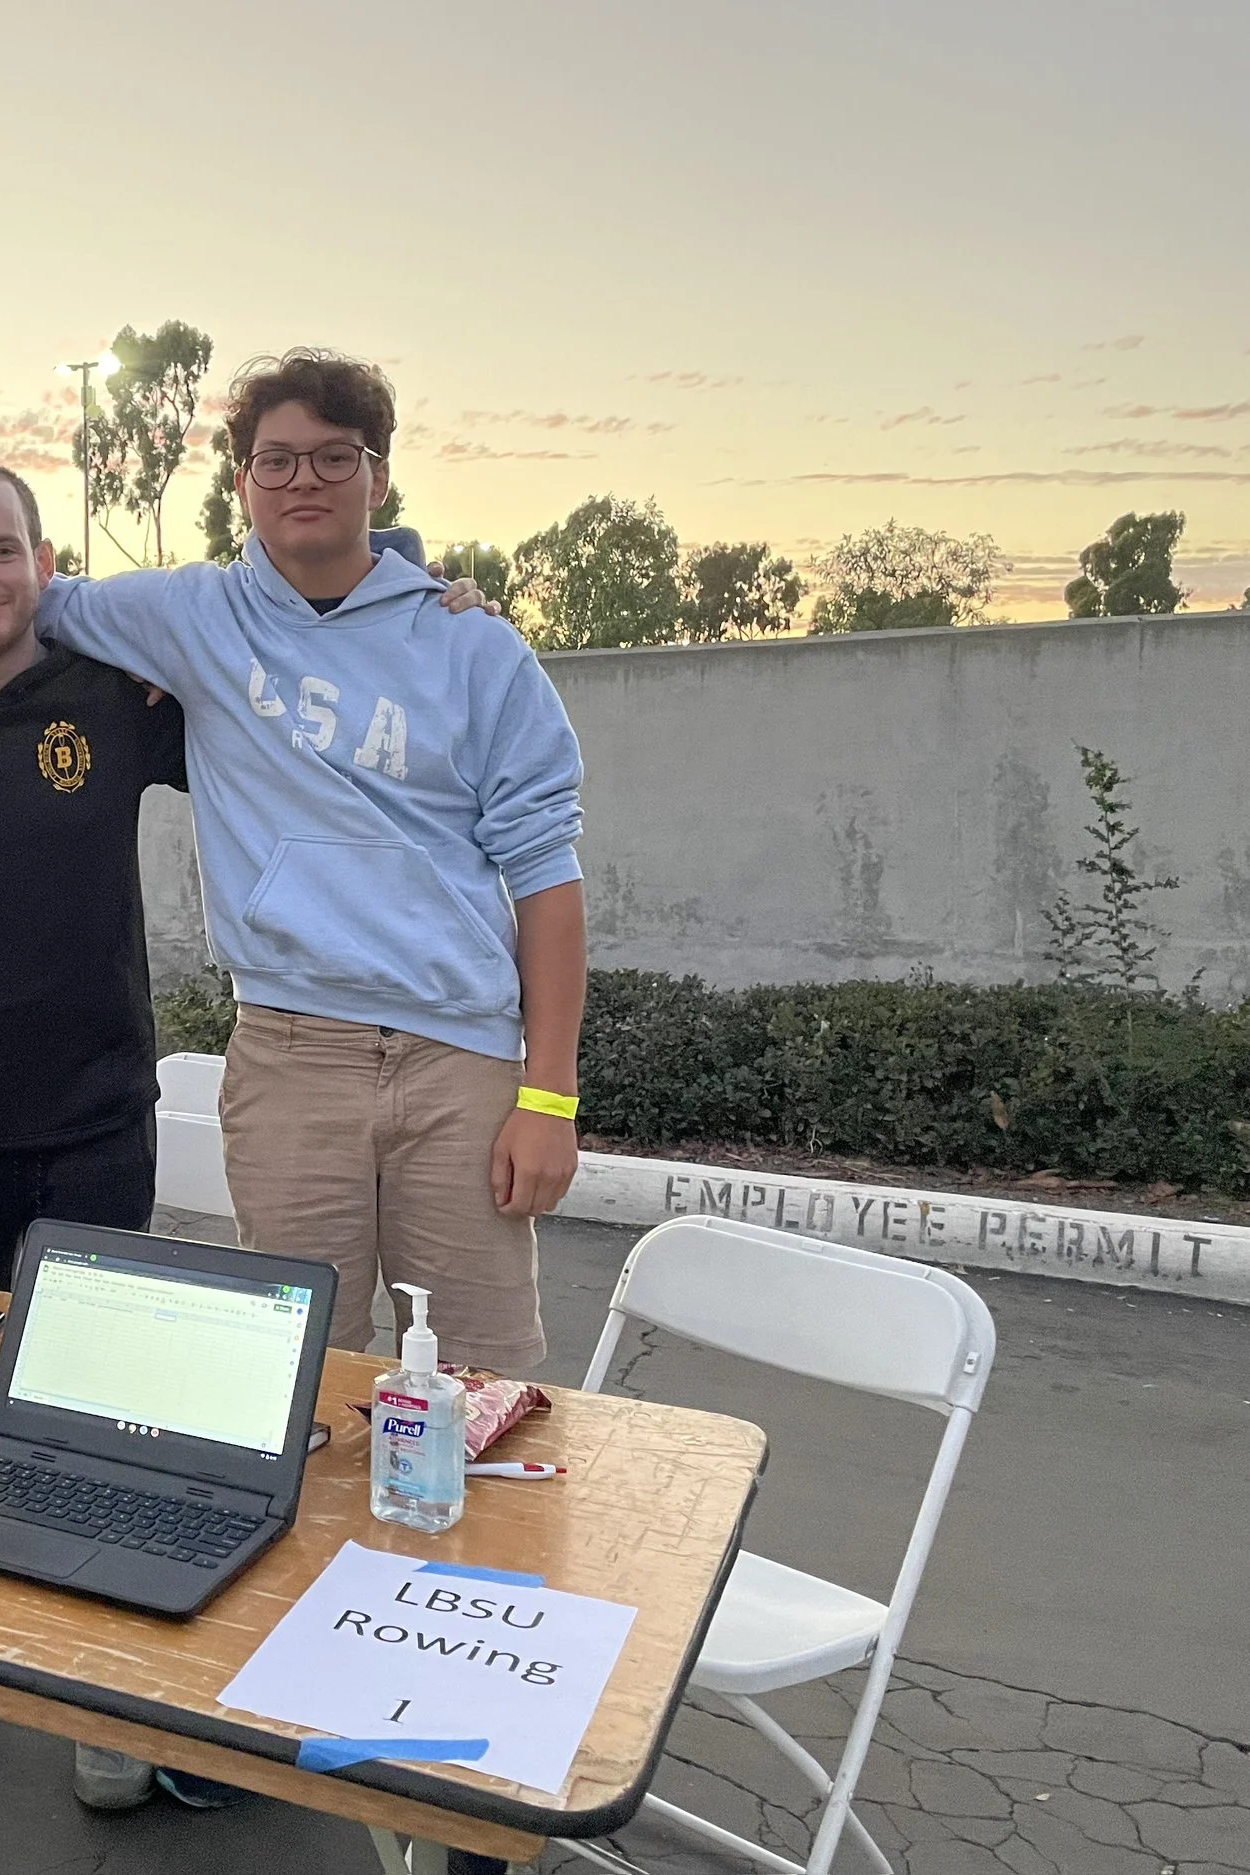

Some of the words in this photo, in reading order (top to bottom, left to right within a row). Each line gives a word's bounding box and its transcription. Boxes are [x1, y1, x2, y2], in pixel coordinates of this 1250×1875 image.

[664, 1175, 949, 1246] EMPLOYEE
[978, 1209, 1212, 1278] PERMIT
[394, 1582, 546, 1630] LBSU
[333, 1609, 563, 1686] Rowing
